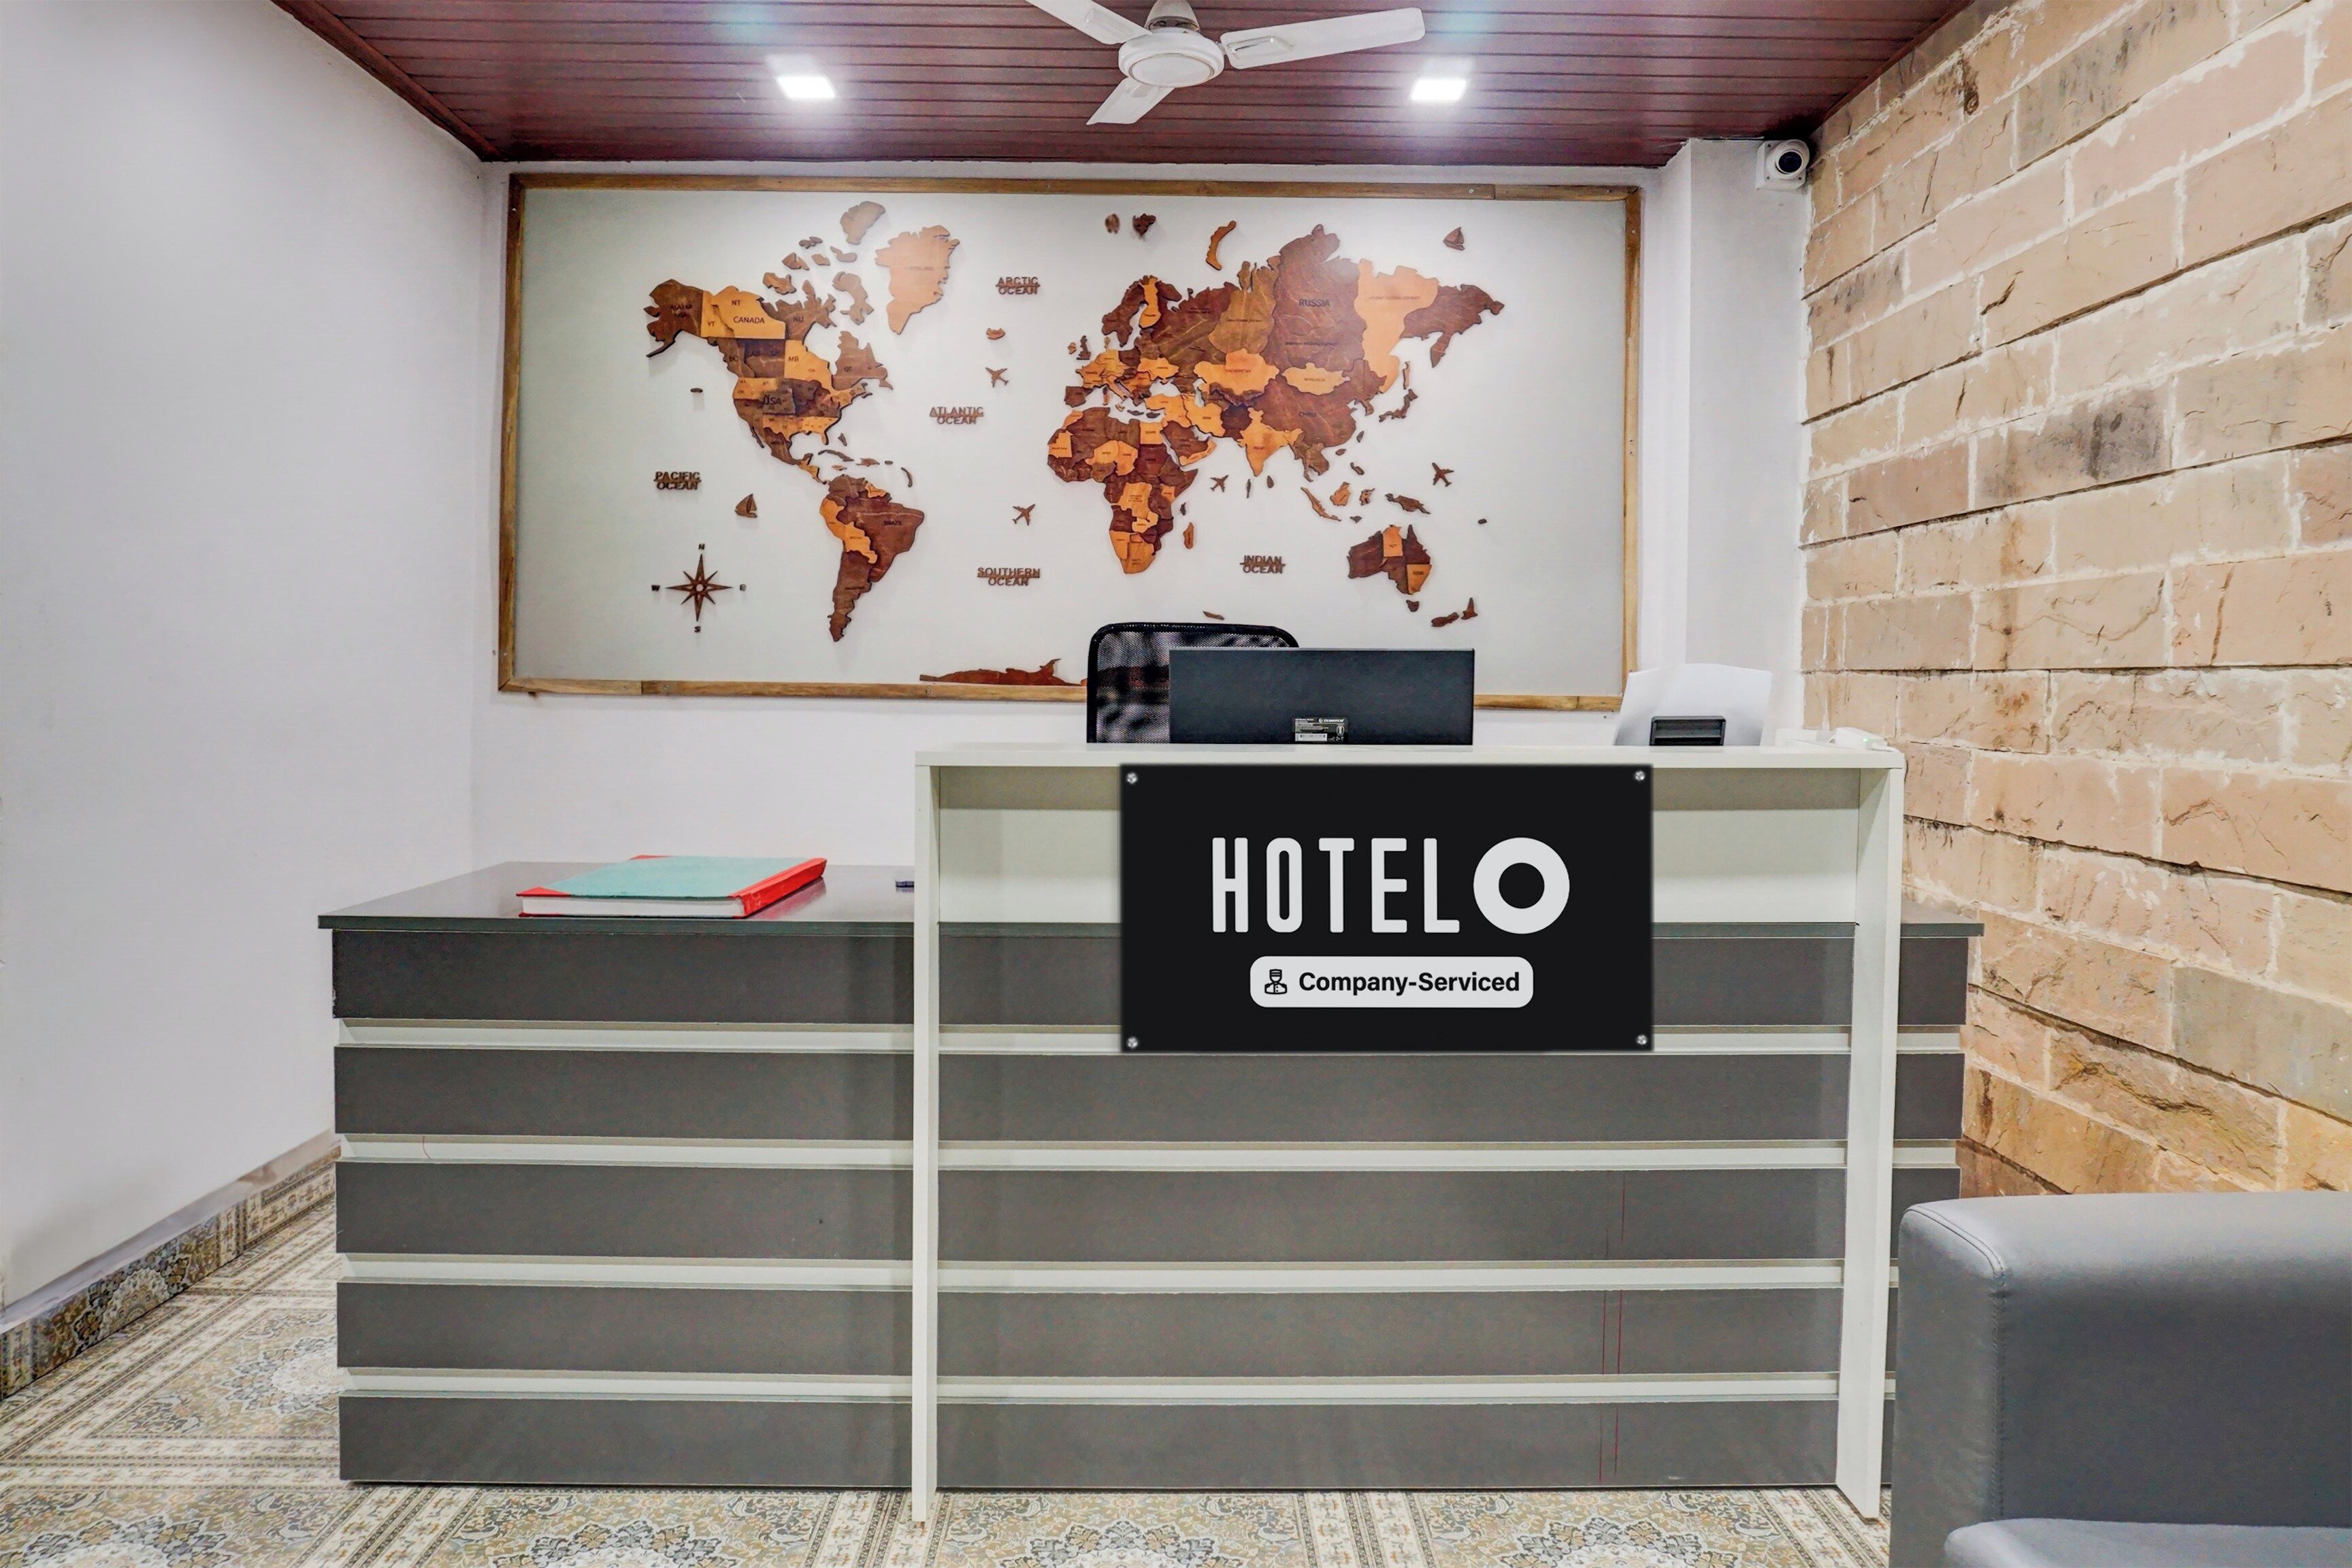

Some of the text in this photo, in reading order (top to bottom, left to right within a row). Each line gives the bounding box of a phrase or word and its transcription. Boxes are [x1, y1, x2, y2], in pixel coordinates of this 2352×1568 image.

[996, 276, 1040, 287] ARCTIC
[998, 285, 1038, 295] OCEAN
[1298, 298, 1330, 307] RUSSIA
[733, 316, 765, 324] CANADA
[929, 406, 984, 416] ATLANTIC
[936, 415, 977, 425] OCEAN
[654, 471, 702, 482] PACIFIC
[656, 480, 699, 490] OCEAN
[1242, 555, 1284, 566] INDIAN
[977, 567, 1041, 578] SOUTHERN
[1242, 564, 1284, 574] OCEAN
[988, 577, 1030, 586] OCEAN
[693, 625, 702, 634] S
[1299, 972, 1520, 996] Company-Serviced
